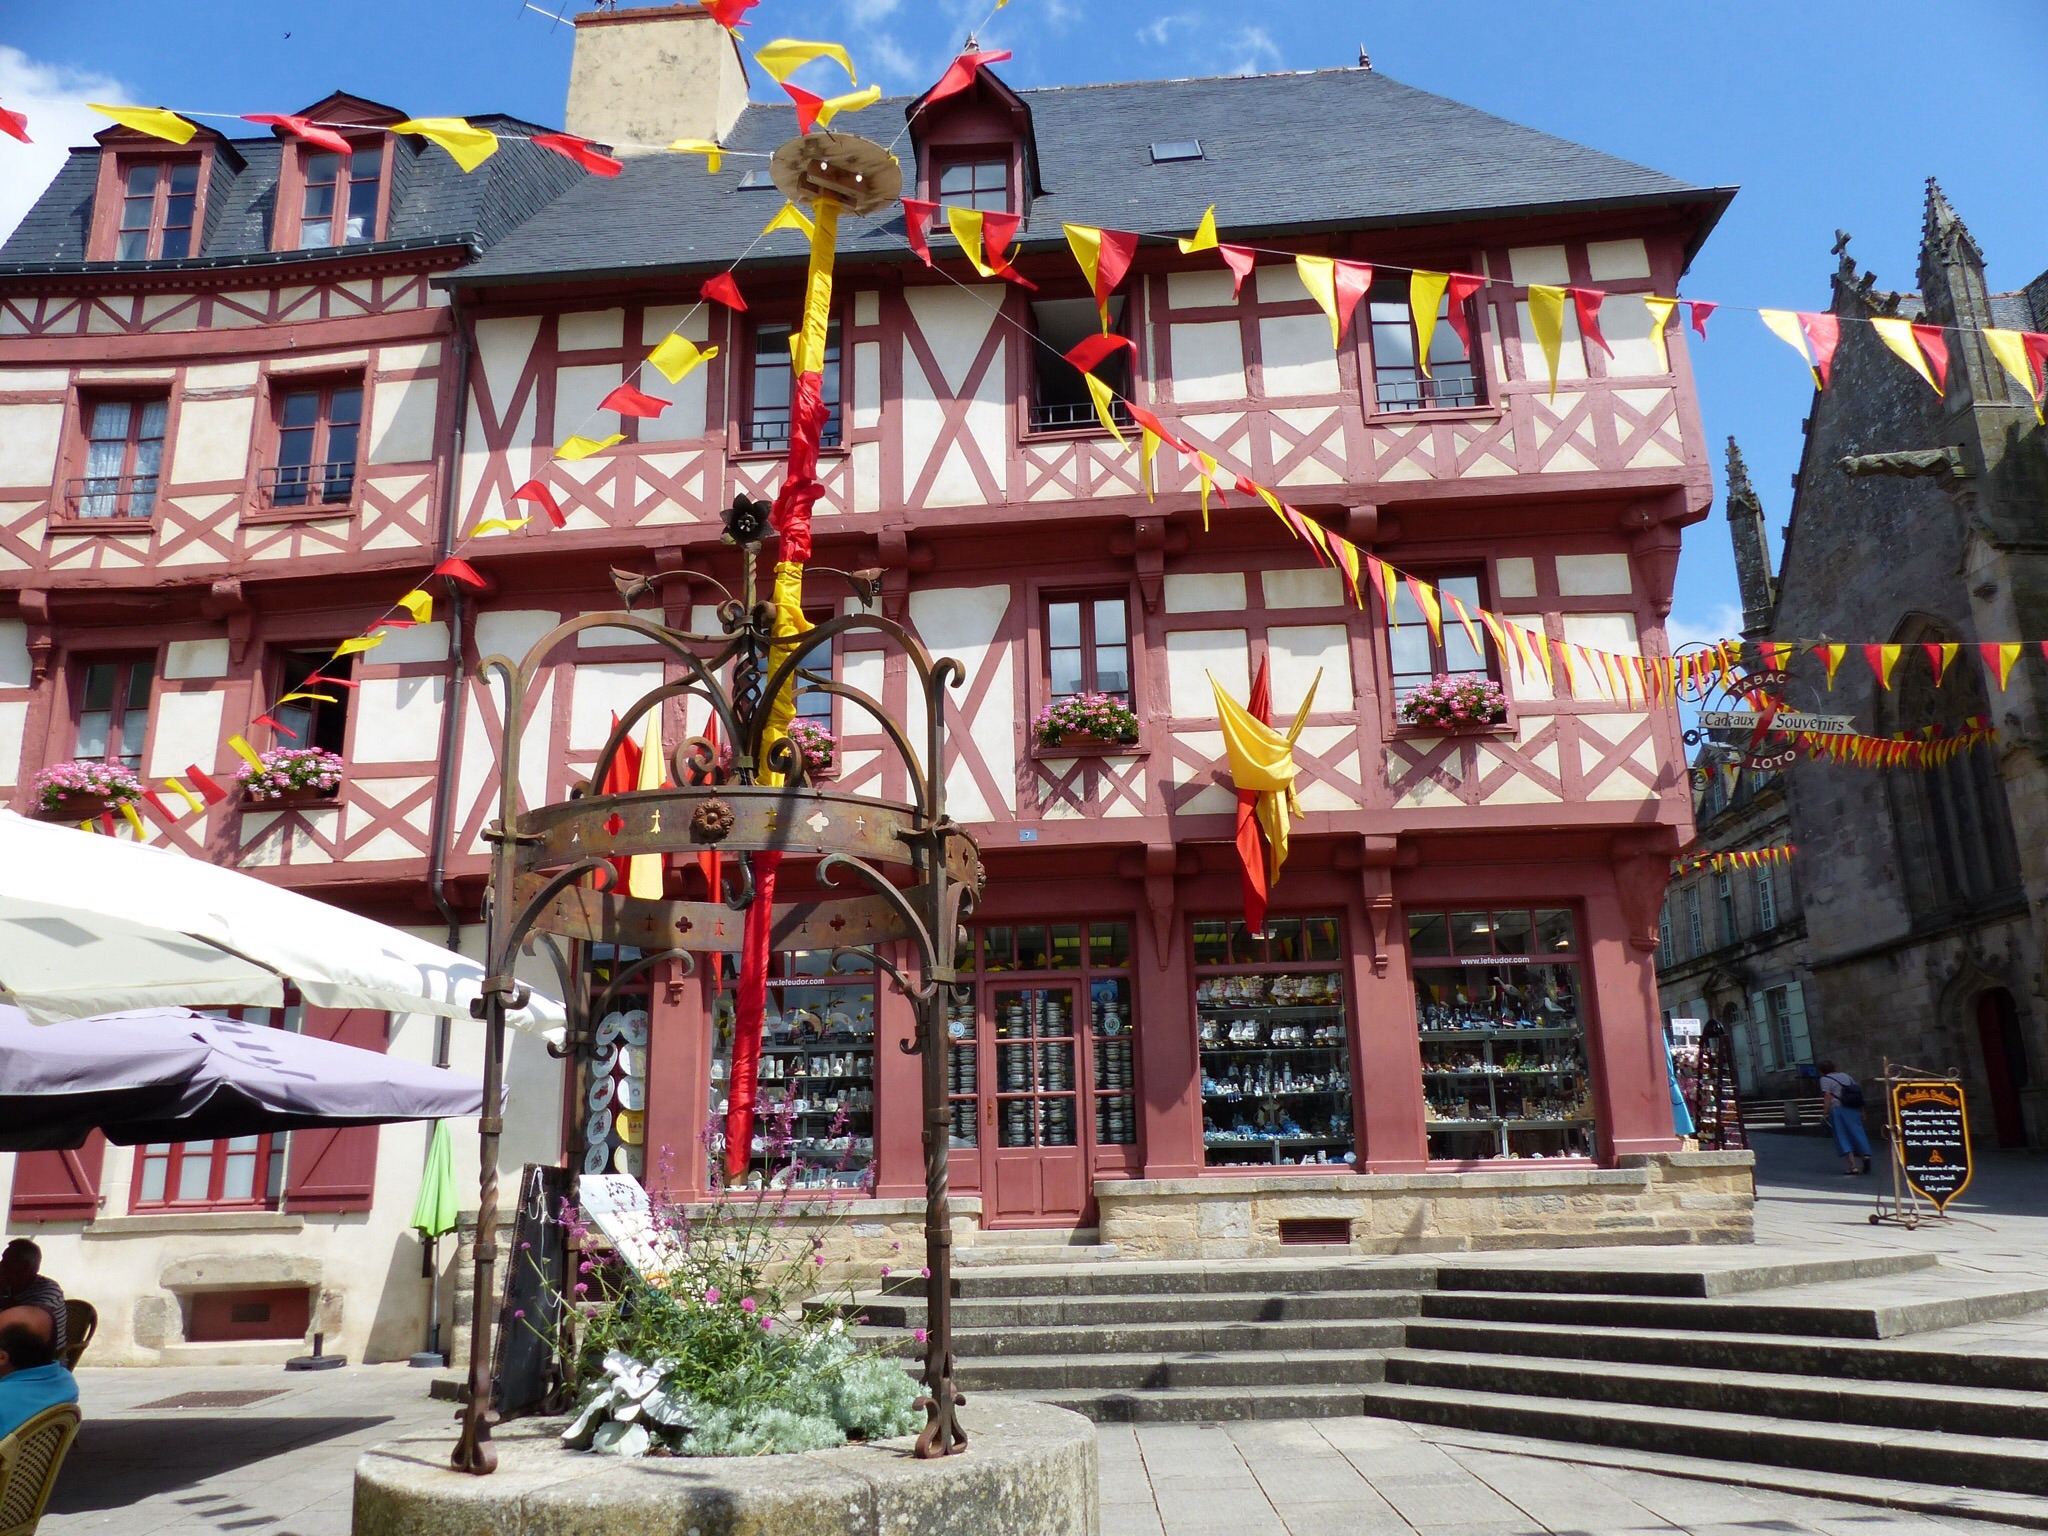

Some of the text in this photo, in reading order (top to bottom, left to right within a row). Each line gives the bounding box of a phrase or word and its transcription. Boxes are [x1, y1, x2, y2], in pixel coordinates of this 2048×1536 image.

[1733, 674, 1787, 694] TABAC
[1704, 712, 1845, 732] Cadeaux Souvenirs
[1752, 750, 1796, 769] LOTO
[1460, 957, 1530, 965] www.lefeudor.com
